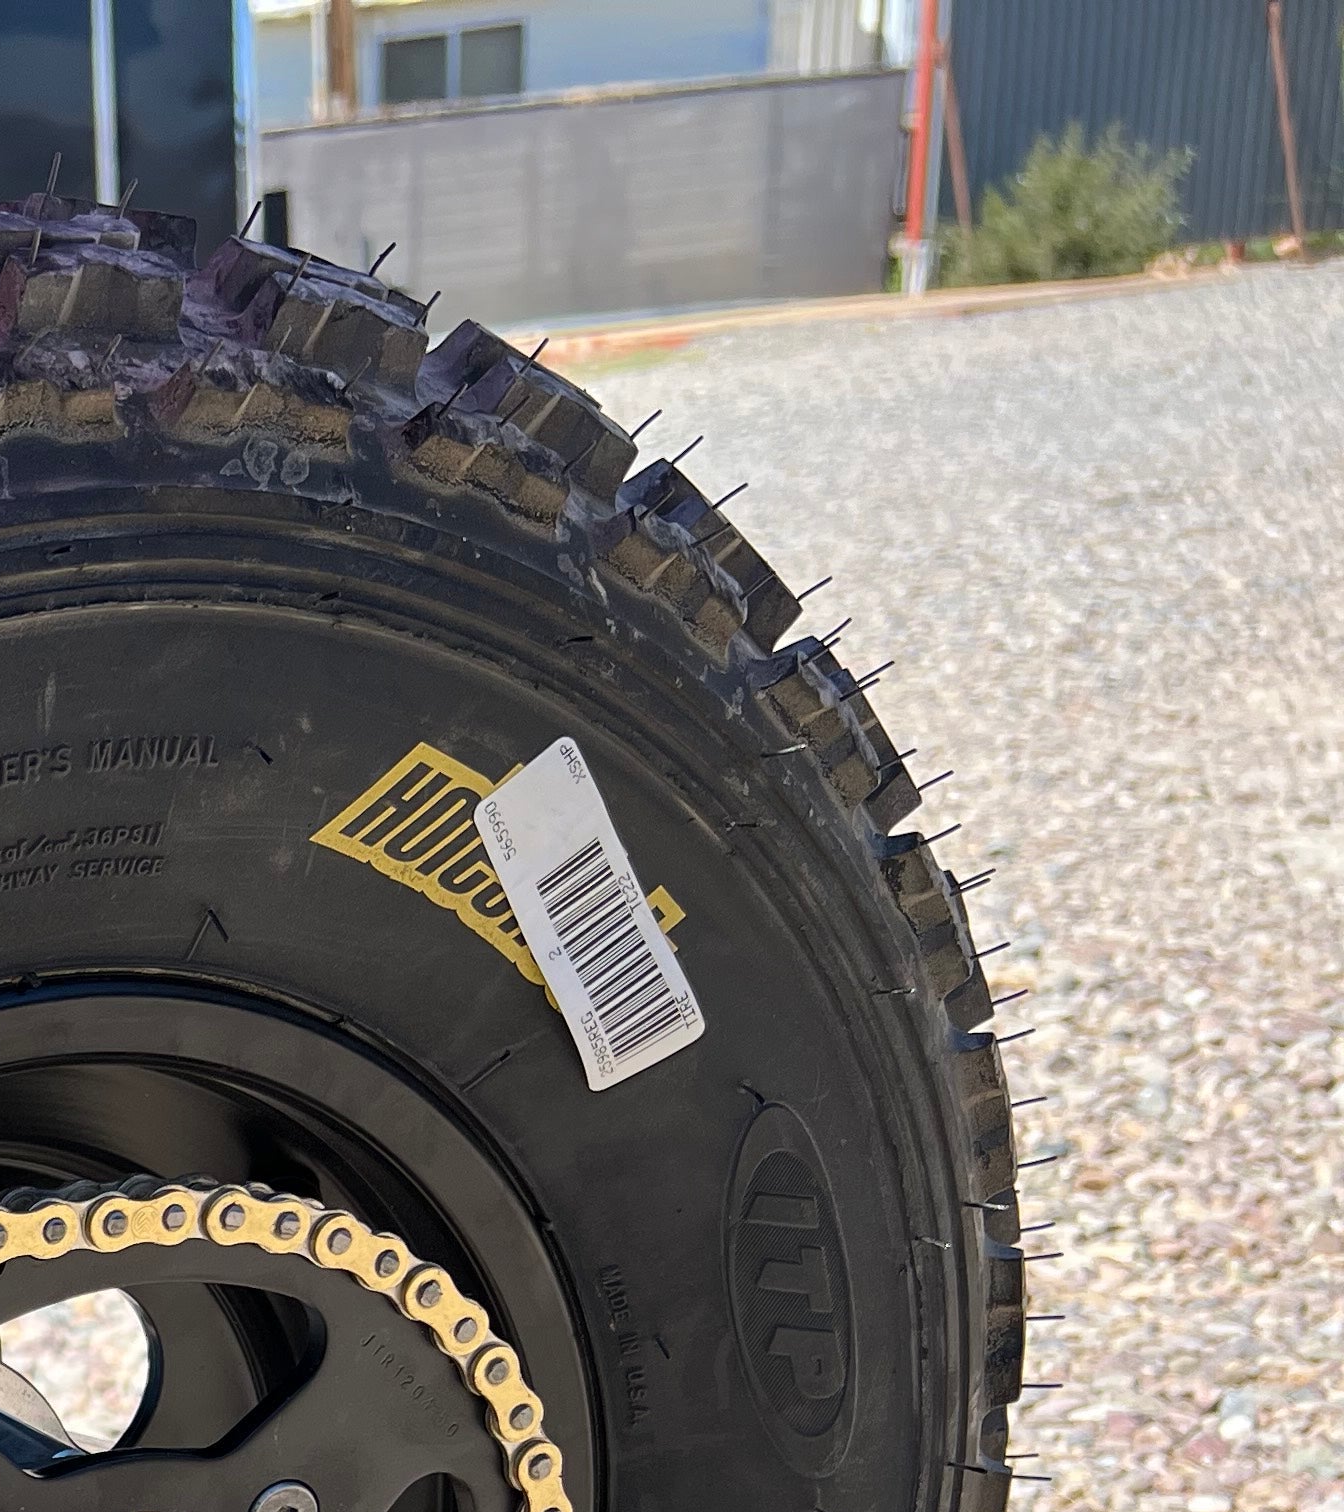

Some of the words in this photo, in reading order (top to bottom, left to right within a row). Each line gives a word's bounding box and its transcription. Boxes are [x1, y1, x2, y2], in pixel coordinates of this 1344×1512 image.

[88, 734, 219, 773] MANUAL
[559, 744, 587, 784] XSHP
[483, 801, 517, 862] 565990
[67, 856, 165, 879] SERVICE
[617, 871, 638, 914] TC22
[548, 947, 562, 960] 2
[677, 990, 697, 1030] TIRE
[600, 1264, 630, 1323] MADE
[618, 1332, 640, 1356] IN
[744, 1192, 847, 1399] ITP
